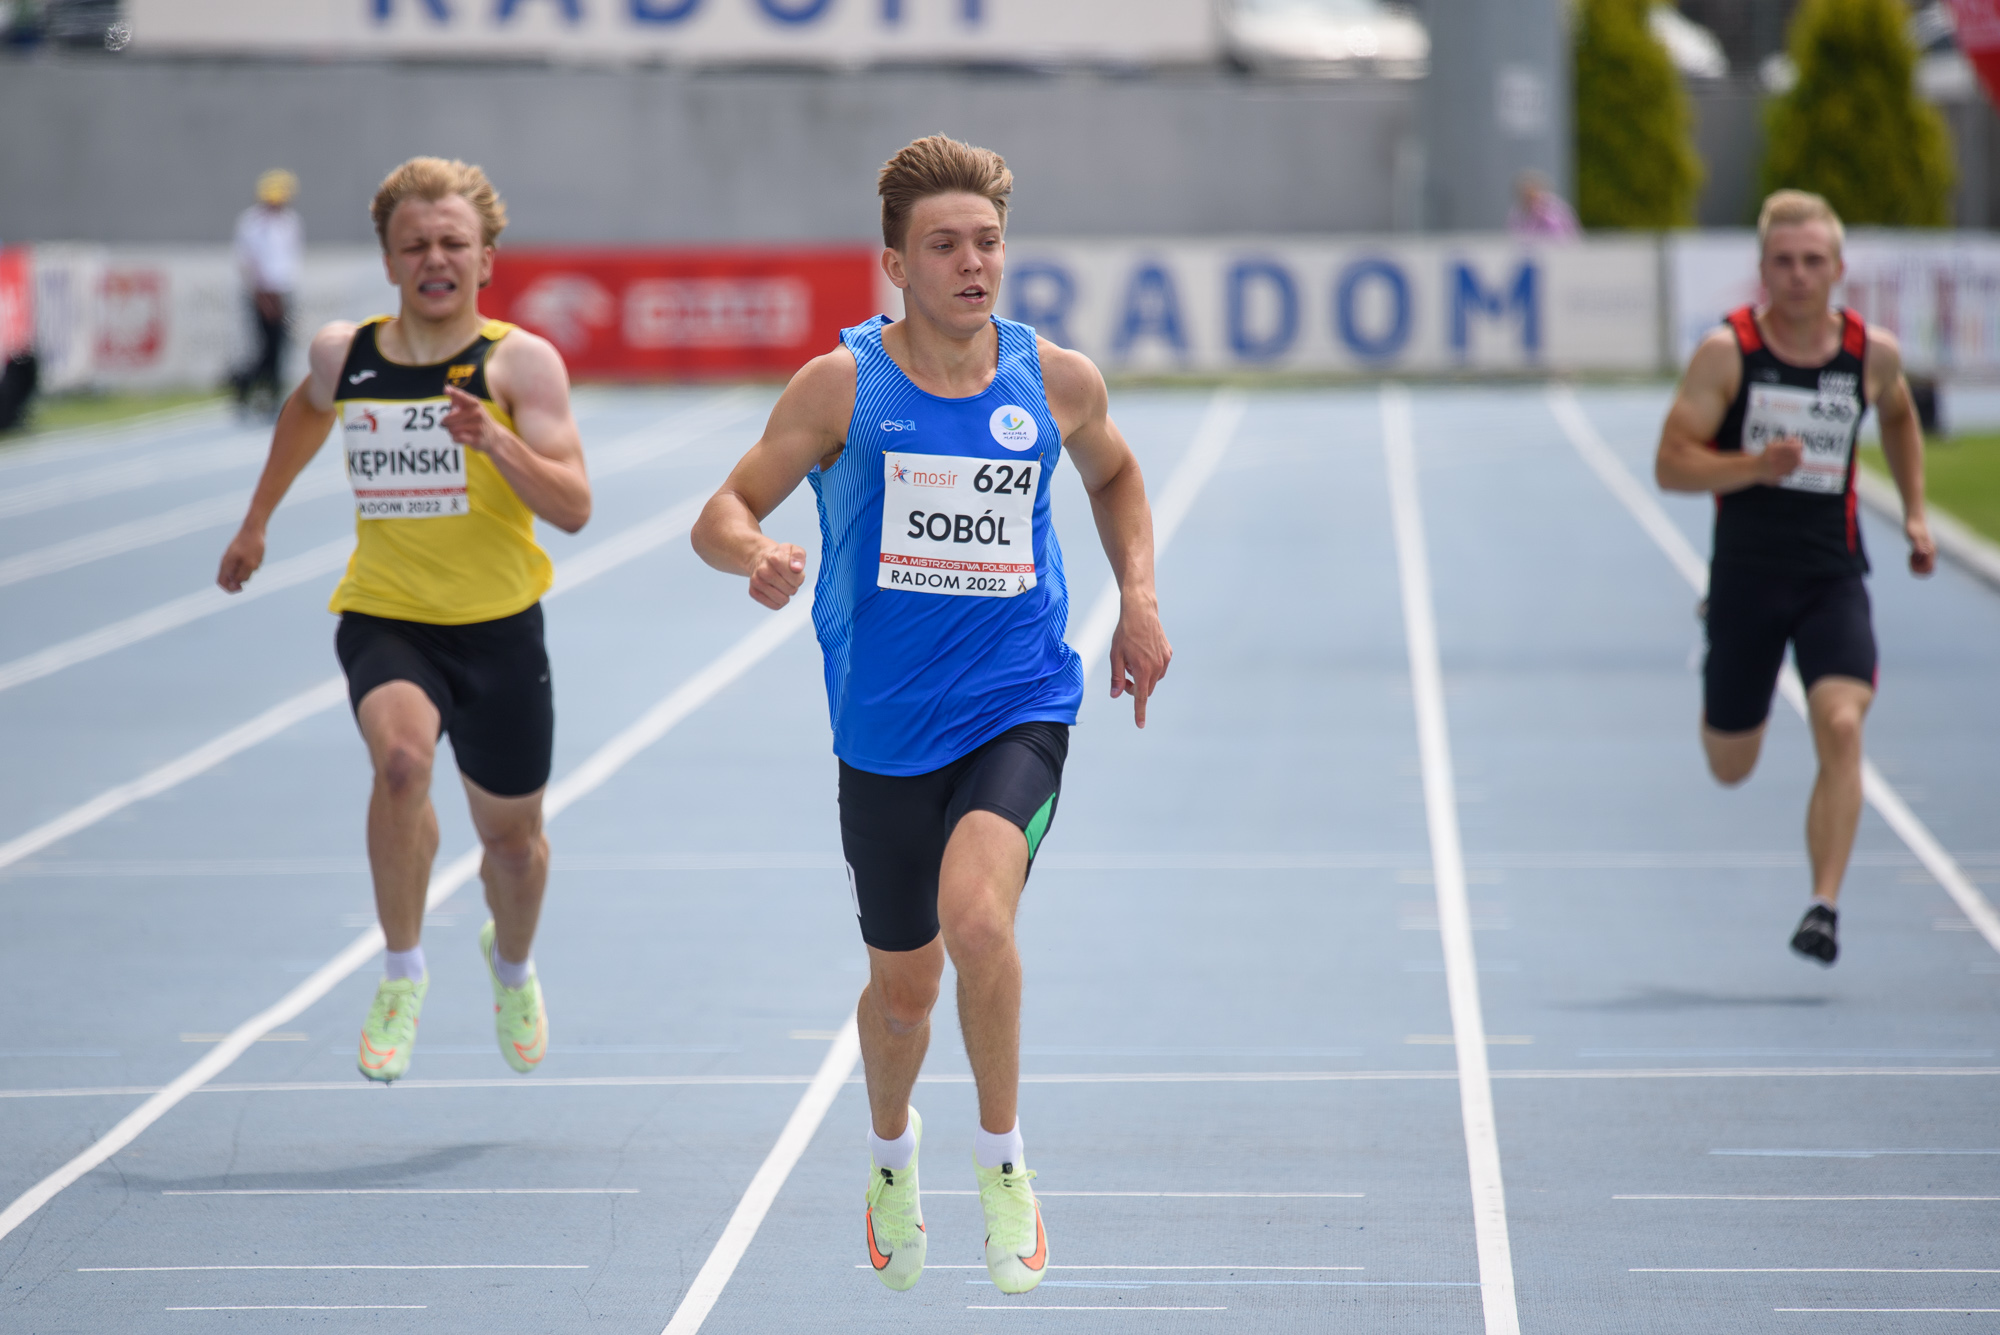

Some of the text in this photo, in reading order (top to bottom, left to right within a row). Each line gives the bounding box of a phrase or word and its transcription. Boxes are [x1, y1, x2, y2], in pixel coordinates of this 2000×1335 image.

[1004, 256, 1541, 363] RADOM
[348, 443, 460, 481] KĘPIŃSKI
[913, 464, 1032, 495] mosir 624
[358, 500, 442, 515] ADOM 2022
[907, 509, 1011, 546] SOBÓL
[883, 554, 1032, 573] PZLA MISTRZOSTWA POLSKI U20
[891, 569, 1007, 592] RADOM 2022
